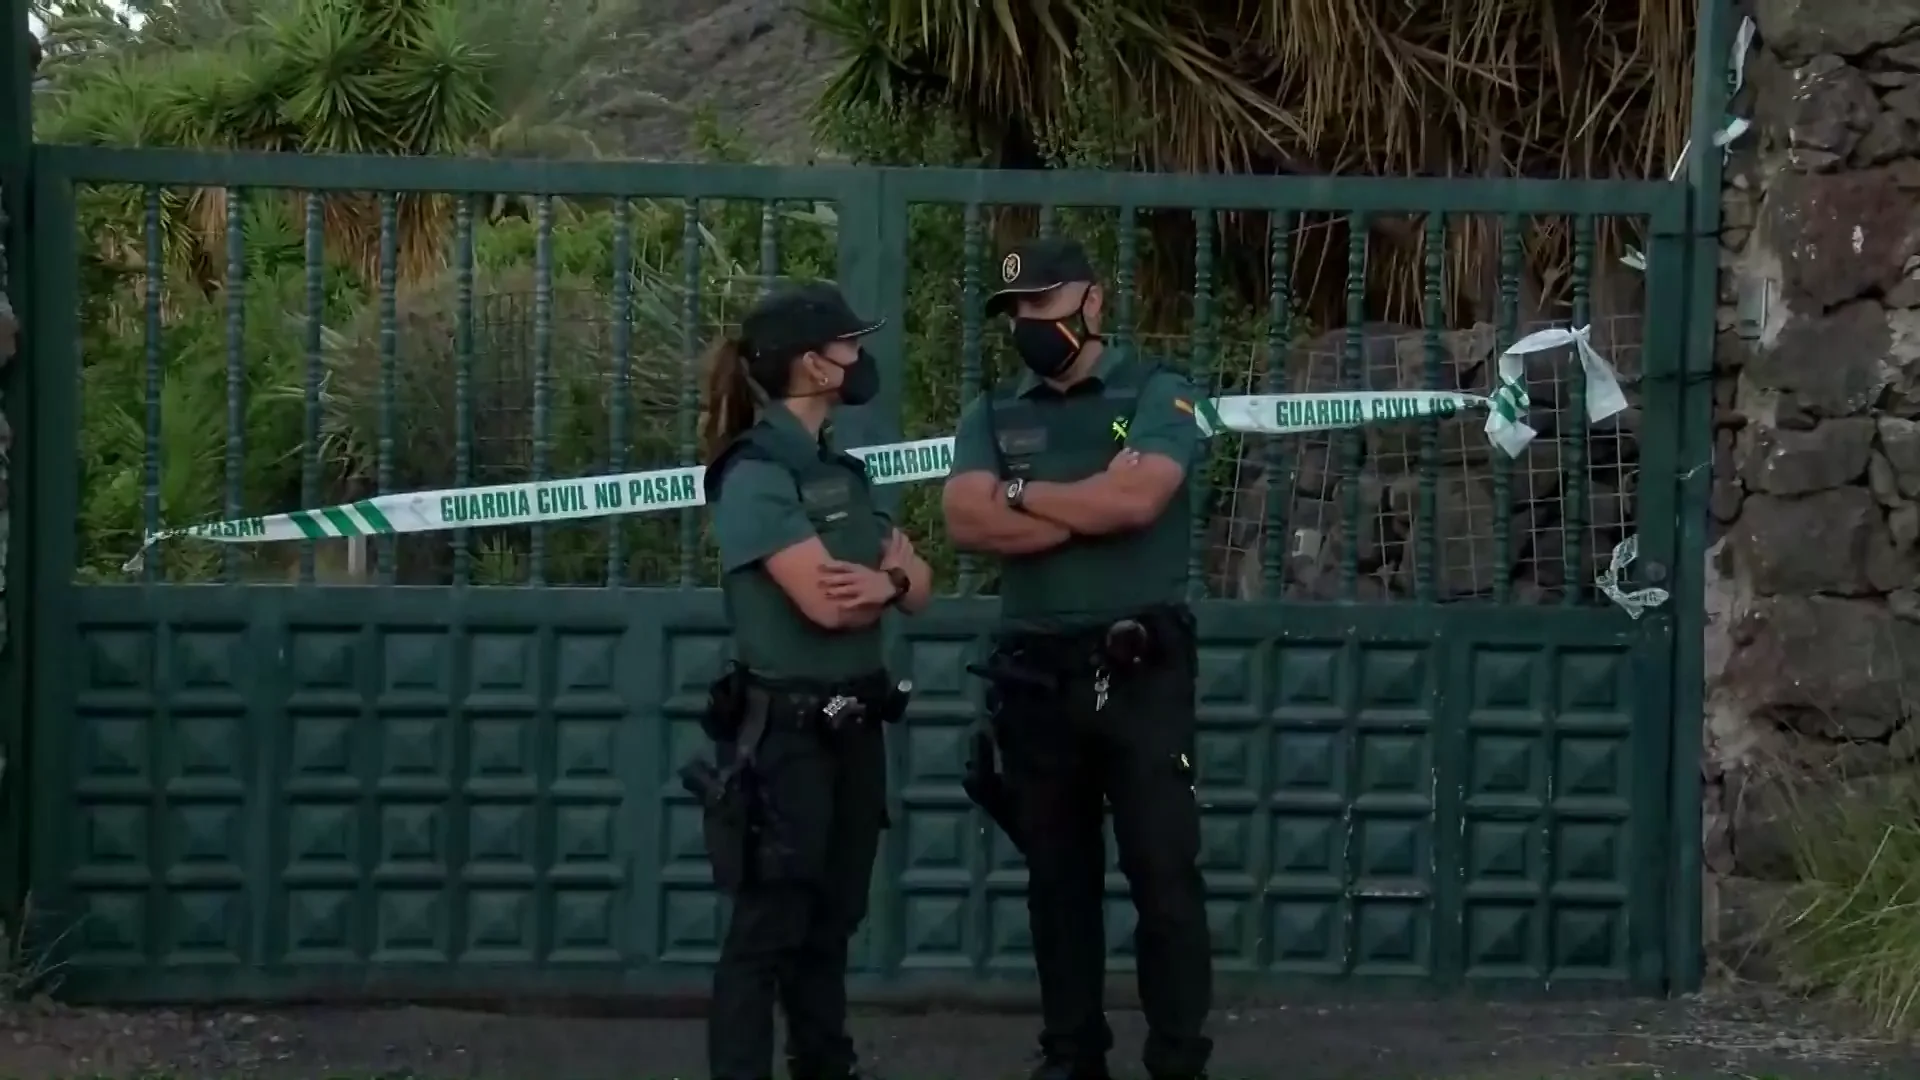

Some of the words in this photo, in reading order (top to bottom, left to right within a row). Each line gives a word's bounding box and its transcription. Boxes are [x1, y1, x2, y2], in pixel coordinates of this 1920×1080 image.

[1276, 399, 1365, 427] GUARDIA
[864, 443, 953, 477] GUARDIA
[440, 489, 530, 522] GUARDIA
[537, 484, 588, 514] CIVIL
[594, 481, 622, 509] NO
[628, 474, 697, 505] PASAR
